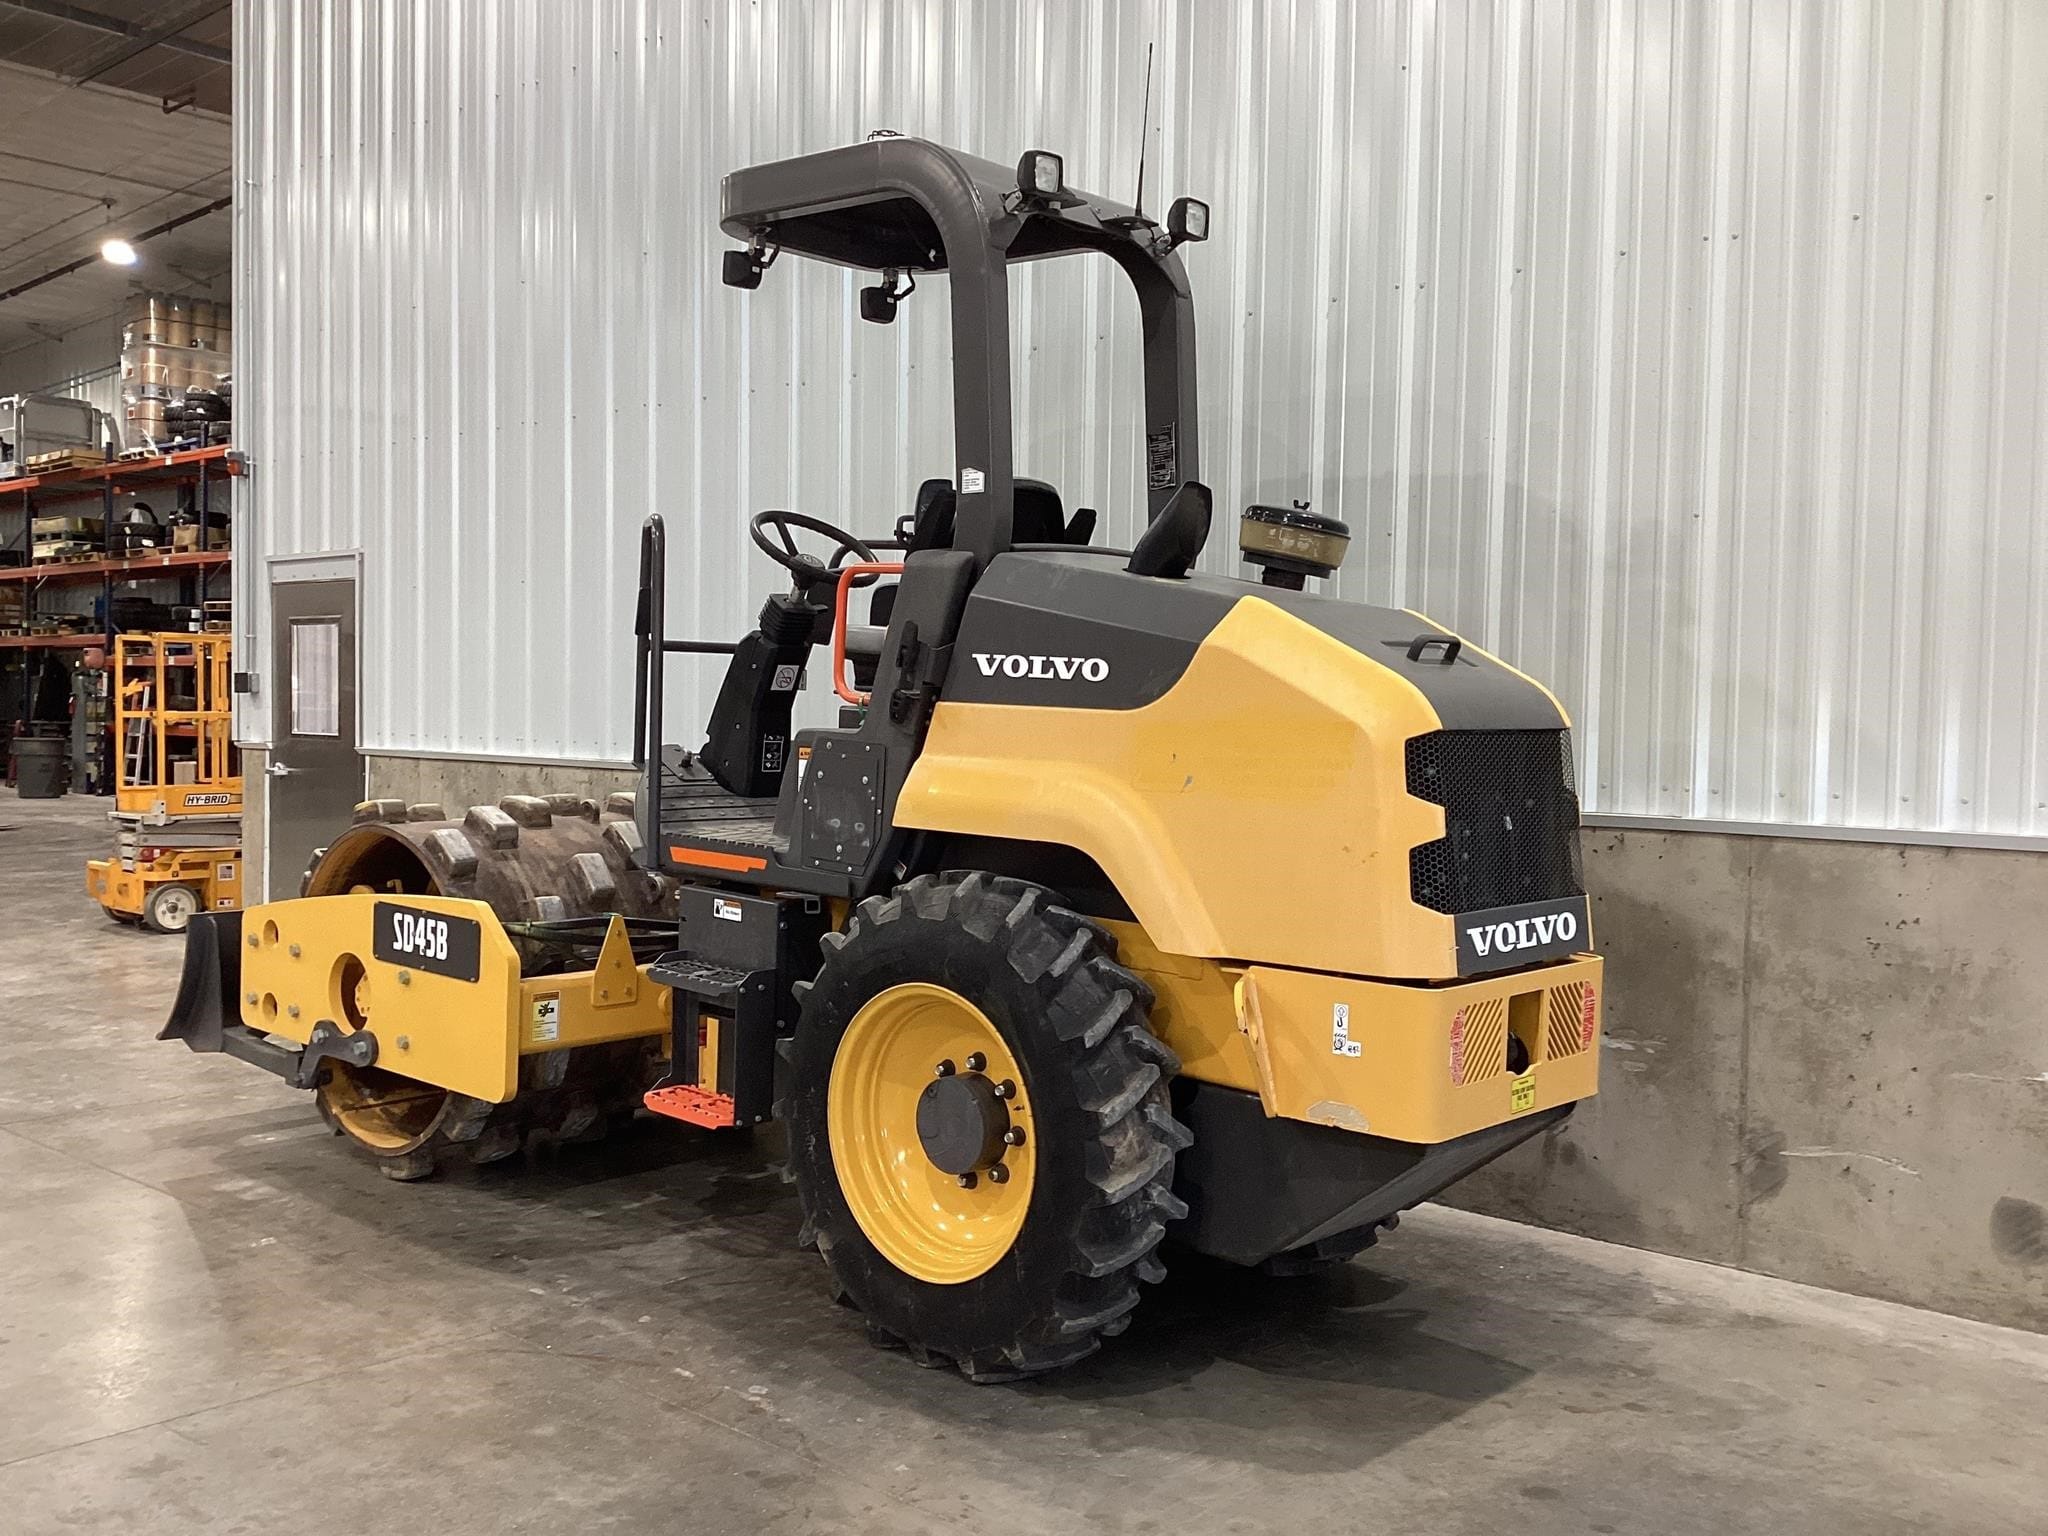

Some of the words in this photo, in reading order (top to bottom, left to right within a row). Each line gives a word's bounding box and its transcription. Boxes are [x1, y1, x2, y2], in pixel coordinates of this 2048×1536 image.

[972, 653, 1109, 682] VOLVO
[187, 795, 228, 805] HY-BRID
[392, 912, 448, 961] SD45B
[1467, 911, 1576, 956] VOLVO
